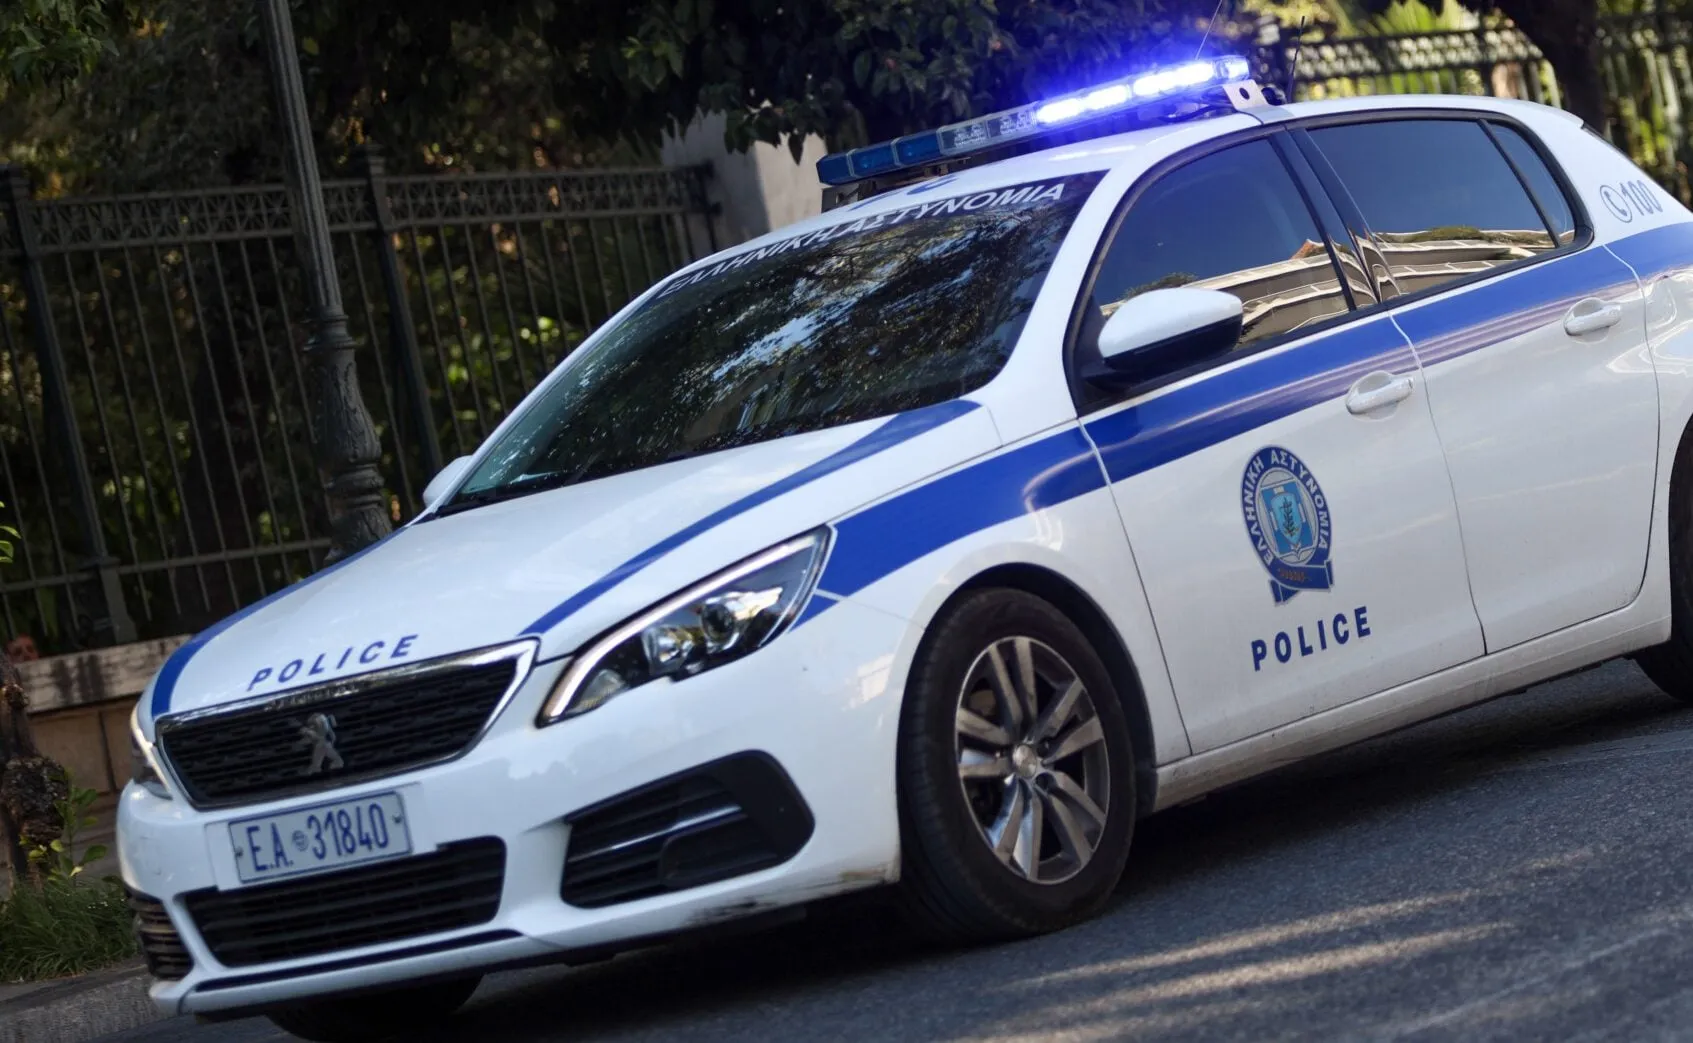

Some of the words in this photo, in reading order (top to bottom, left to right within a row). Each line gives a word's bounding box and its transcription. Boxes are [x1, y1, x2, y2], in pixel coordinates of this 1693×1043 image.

[830, 183, 1065, 240] ΑΣΤΥΝΟΜΙΑ
[1619, 180, 1663, 216] 100
[1243, 456, 1274, 566] ΕΛΛΗΝΙΚΗ
[1270, 449, 1329, 550] ΑΣΤΥΝΟΜΙΑ
[246, 634, 419, 692] POLICE
[1251, 606, 1371, 671] POLICE
[307, 803, 389, 860] 31840
